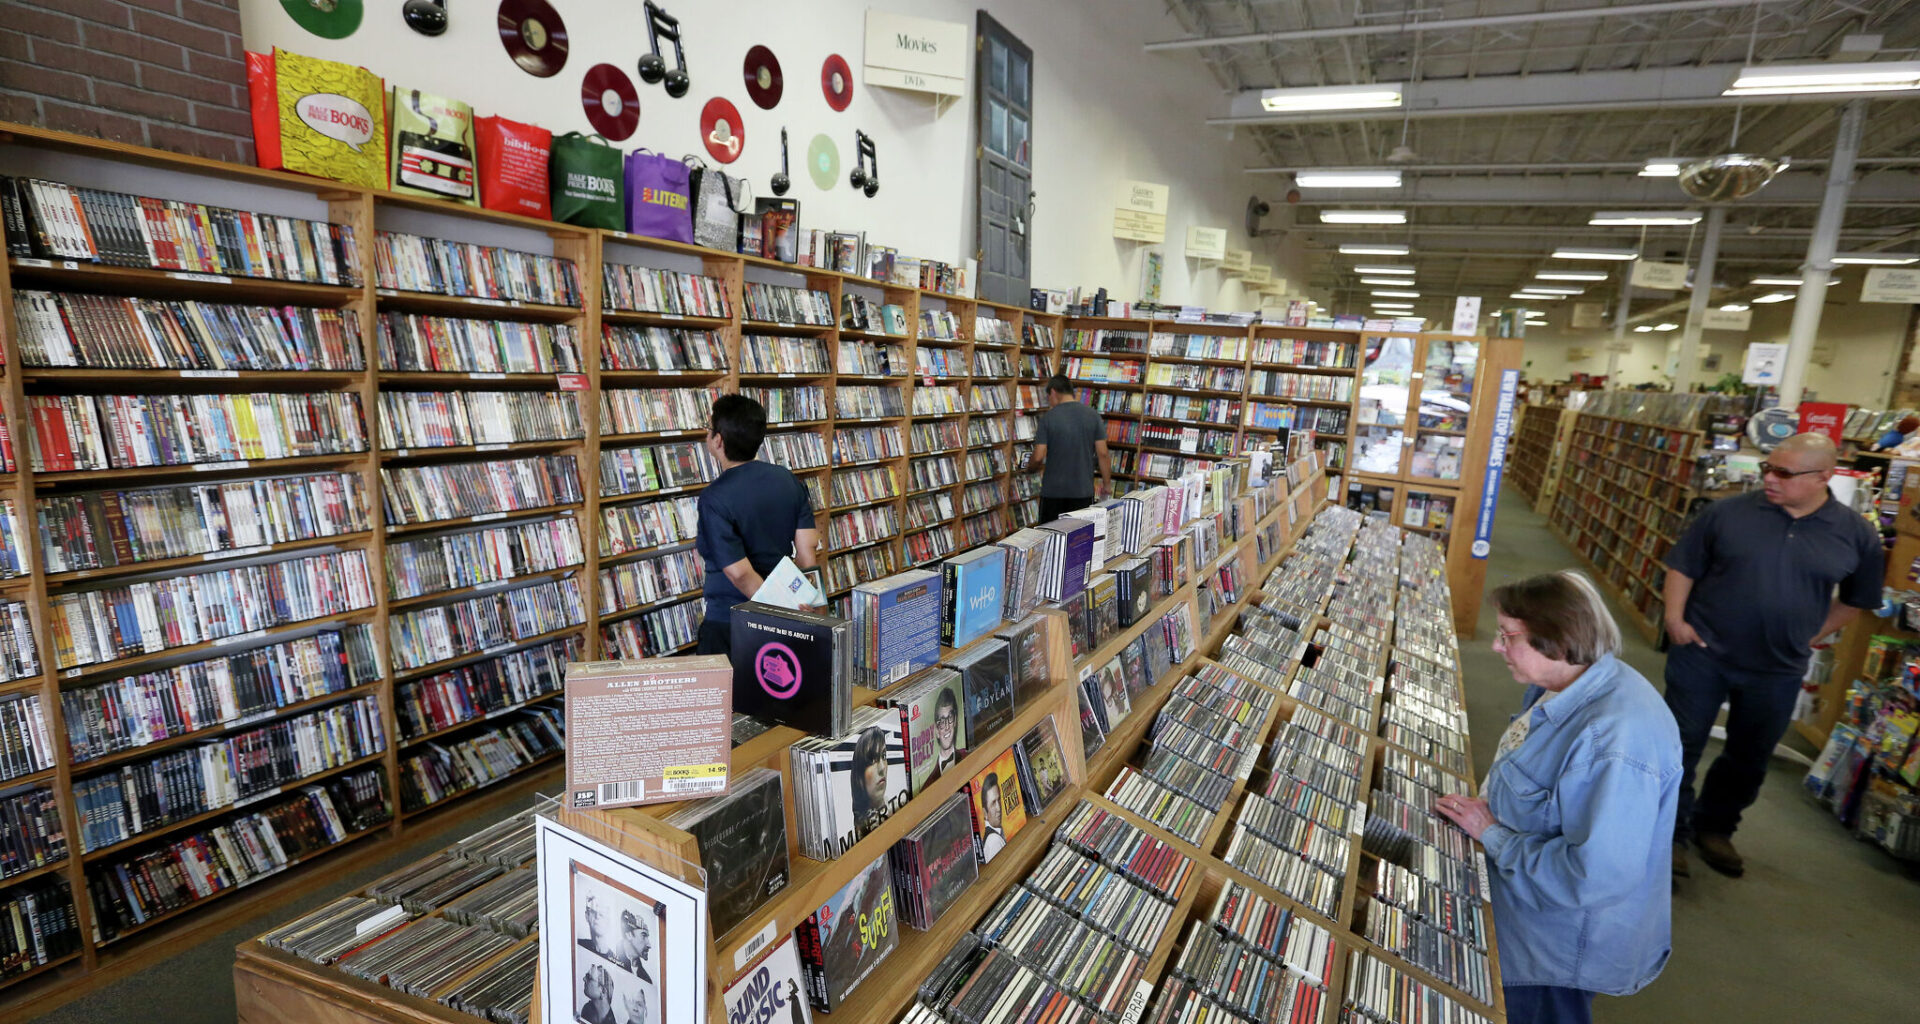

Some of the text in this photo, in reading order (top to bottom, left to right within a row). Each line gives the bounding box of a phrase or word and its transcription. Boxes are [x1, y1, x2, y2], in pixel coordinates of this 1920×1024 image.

[896, 32, 937, 54] Movies
[904, 74, 925, 87] DVDs
[330, 109, 369, 135] BOOKS
[567, 172, 586, 181] HALF
[587, 175, 615, 197] BOOKS
[1488, 370, 1518, 467] NEW TABLETOP GAMES
[1805, 412, 1838, 427] Greeting
[747, 621, 757, 629] THIS
[763, 625, 776, 633] WHAT
[793, 631, 810, 641] ABOUT
[643, 677, 697, 687] BROTHERS
[984, 685, 1012, 711] DYLAN
[912, 742, 935, 769] HOLLY
[575, 791, 593, 799] JSP
[1004, 791, 1020, 816] CASH
[858, 885, 894, 950] SURF!
[810, 928, 823, 966] SURF!
